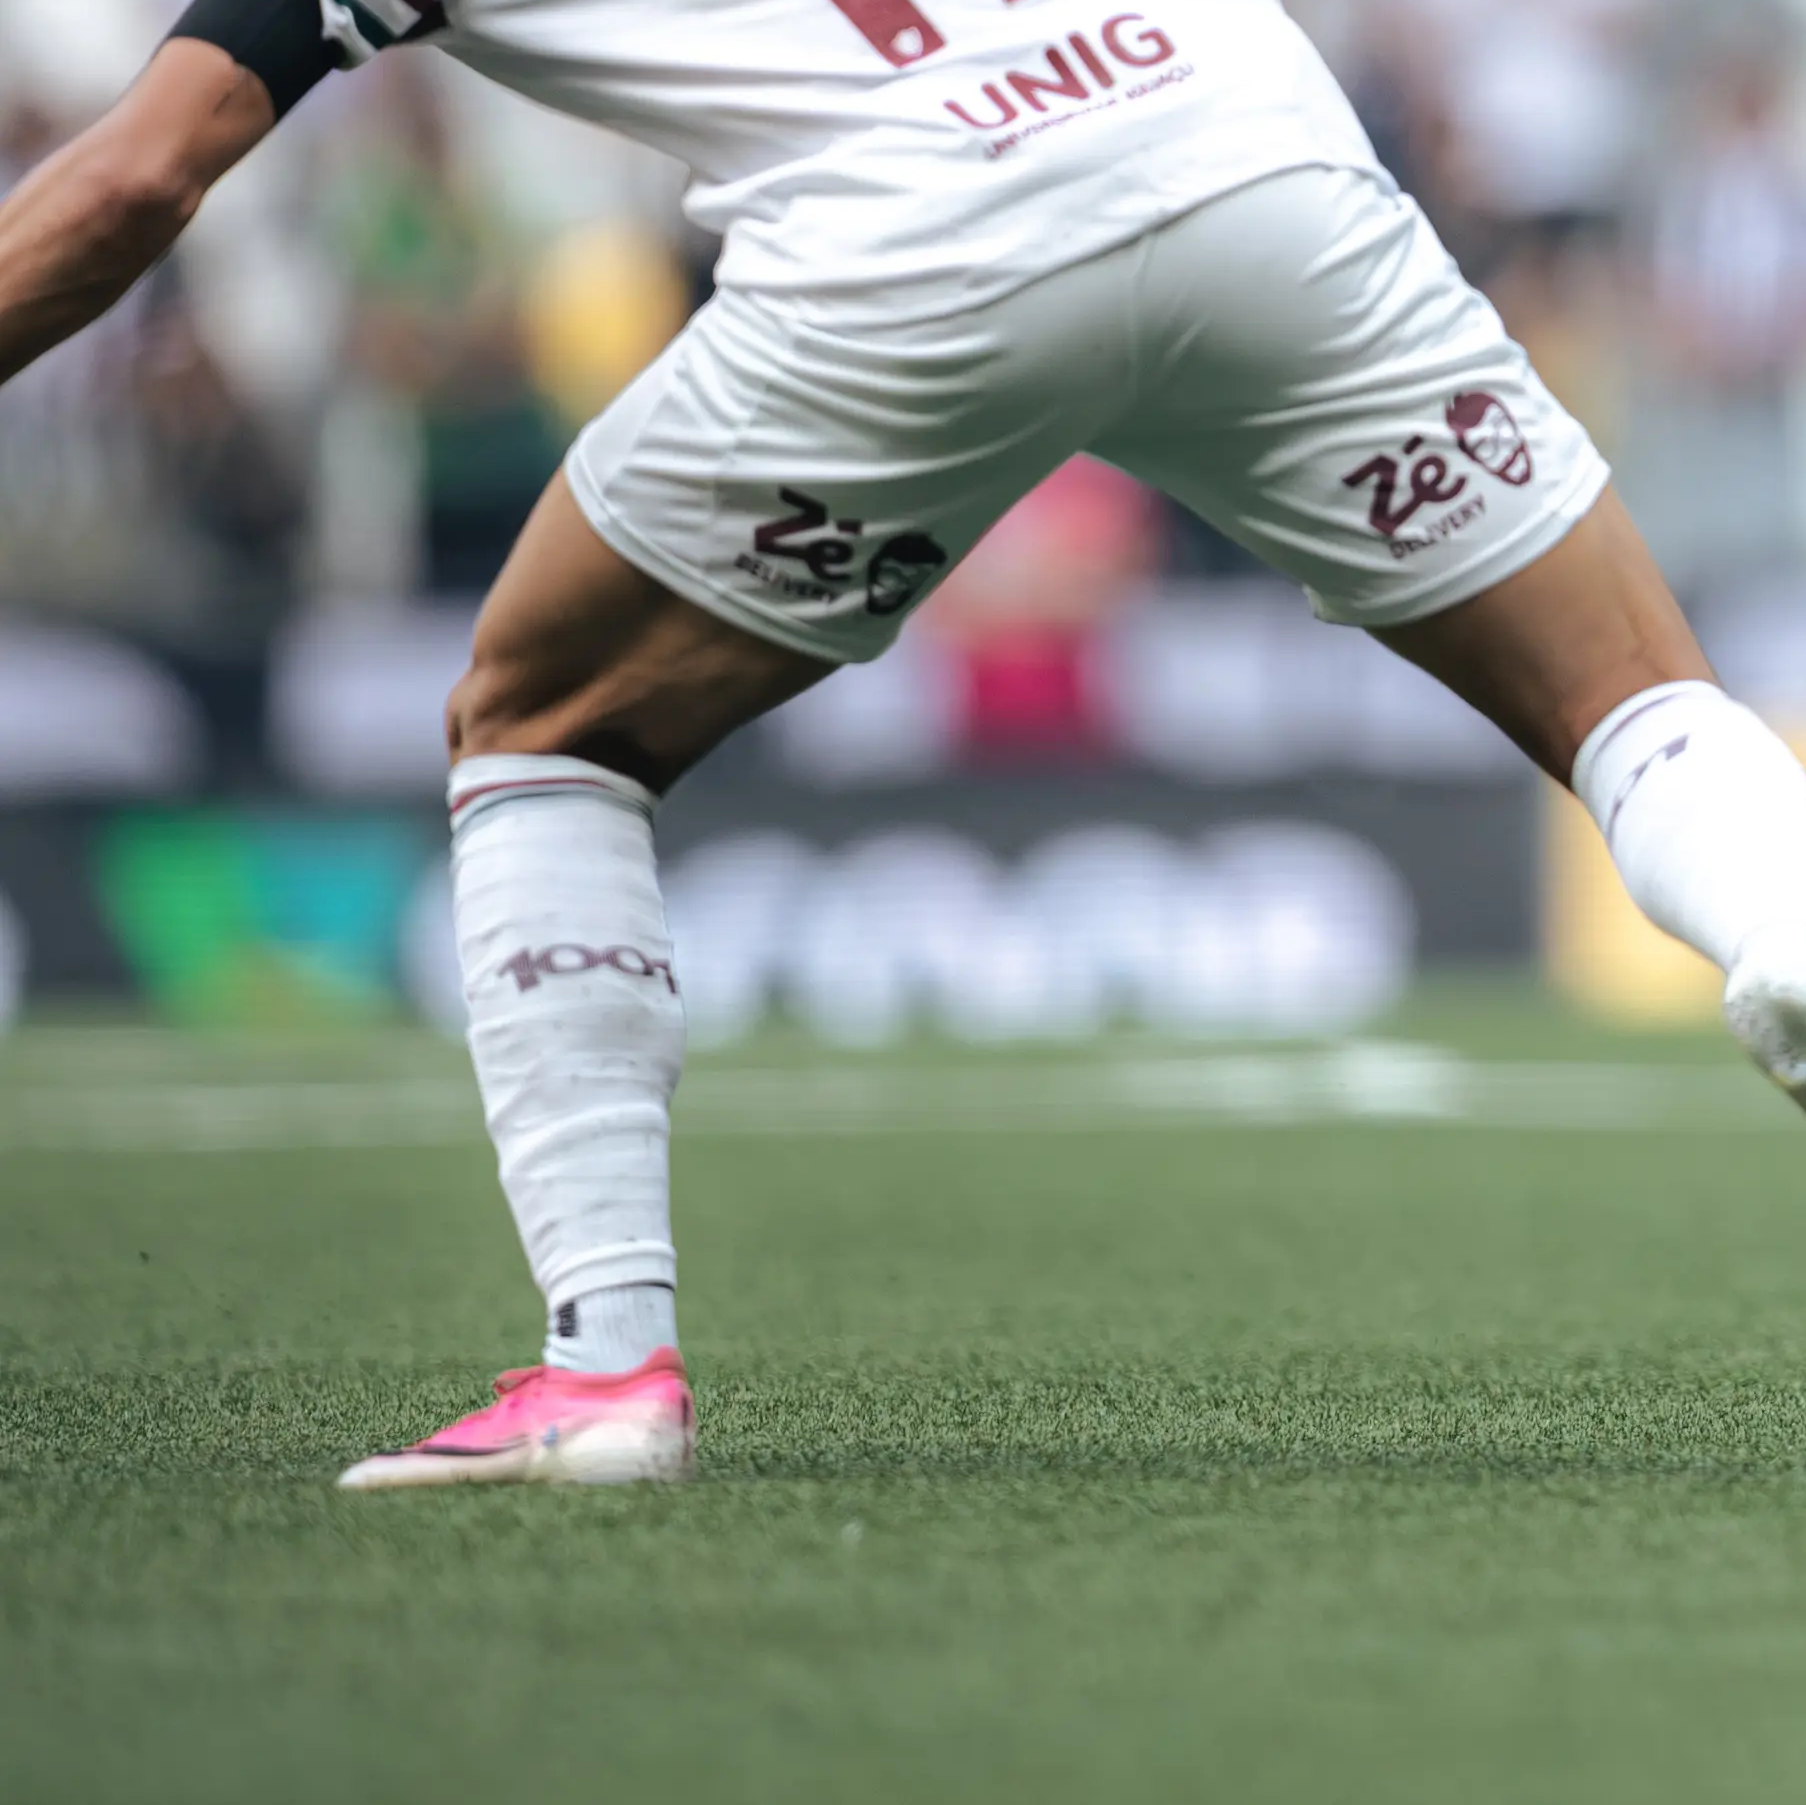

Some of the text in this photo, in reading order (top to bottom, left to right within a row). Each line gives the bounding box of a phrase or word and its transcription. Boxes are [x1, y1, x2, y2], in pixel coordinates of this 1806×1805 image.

[943, 11, 1177, 130] UNIG
[755, 484, 863, 581] Zé
[1342, 434, 1468, 537] Zé
